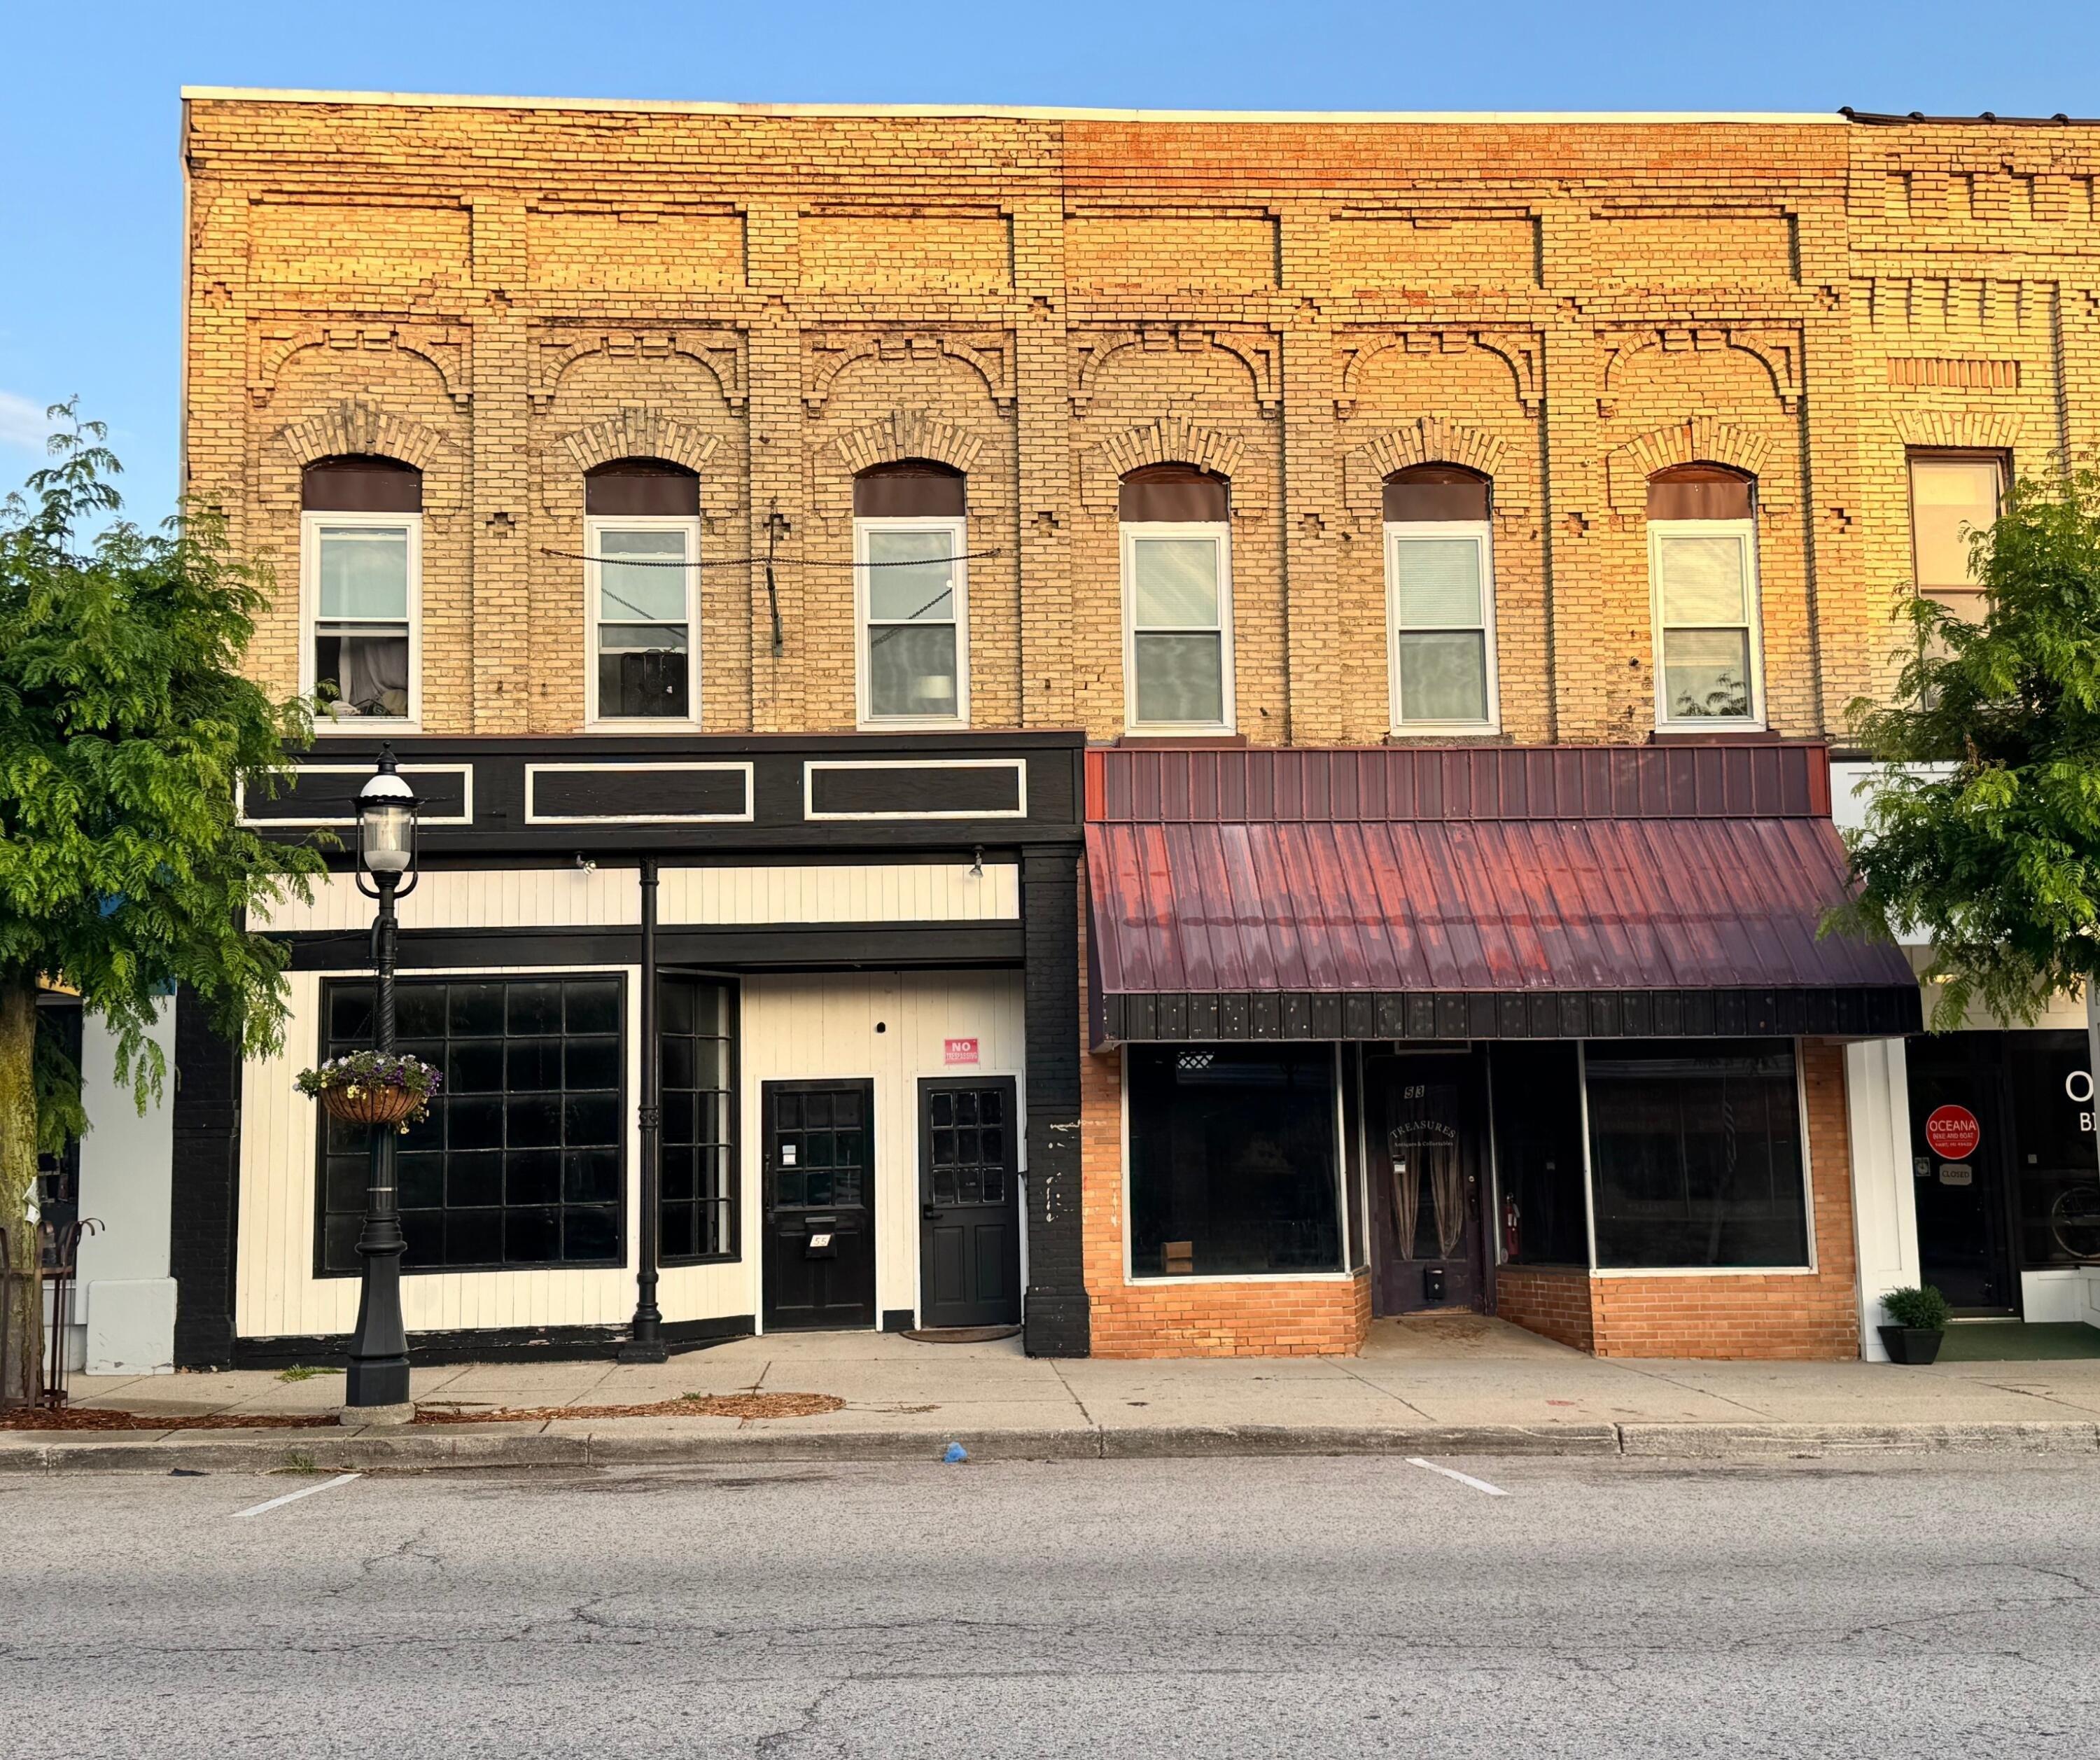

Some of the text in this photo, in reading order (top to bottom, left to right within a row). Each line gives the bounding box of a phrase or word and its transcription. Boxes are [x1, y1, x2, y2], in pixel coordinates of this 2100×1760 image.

[952, 1042, 971, 1052] NO
[1405, 1085, 1424, 1098] 53
[2066, 1070, 2094, 1102] O
[1390, 1120, 1456, 1138] TREASURES
[1929, 1120, 1977, 1131] OCEANA
[813, 1237, 827, 1245] 55
